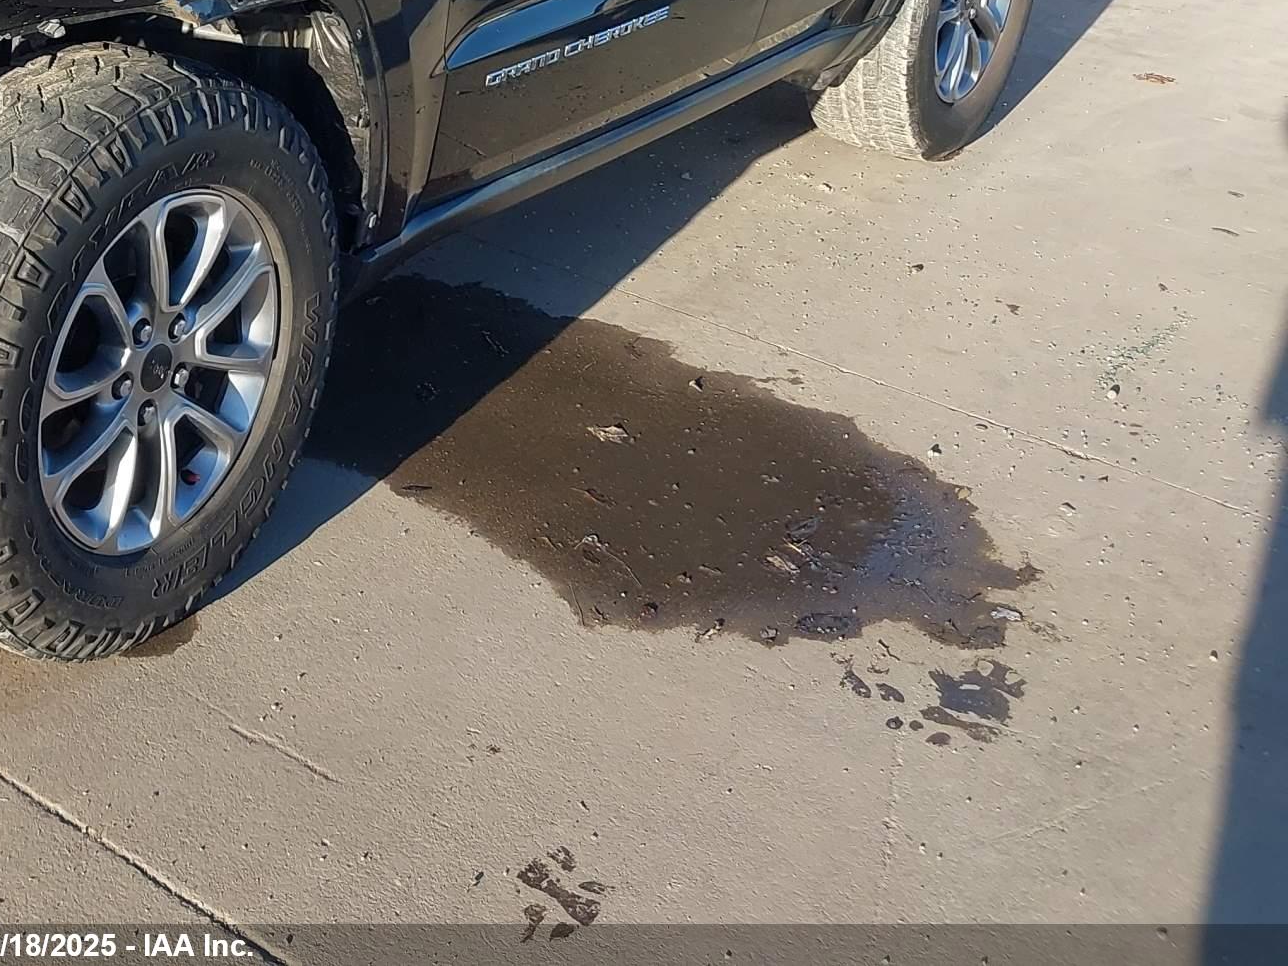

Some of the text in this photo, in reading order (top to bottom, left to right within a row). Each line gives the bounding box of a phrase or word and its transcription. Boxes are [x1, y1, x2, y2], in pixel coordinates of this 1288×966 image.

[485, 5, 670, 86] GRAND CHEROKEE
[152, 292, 320, 599] WRANGLER
